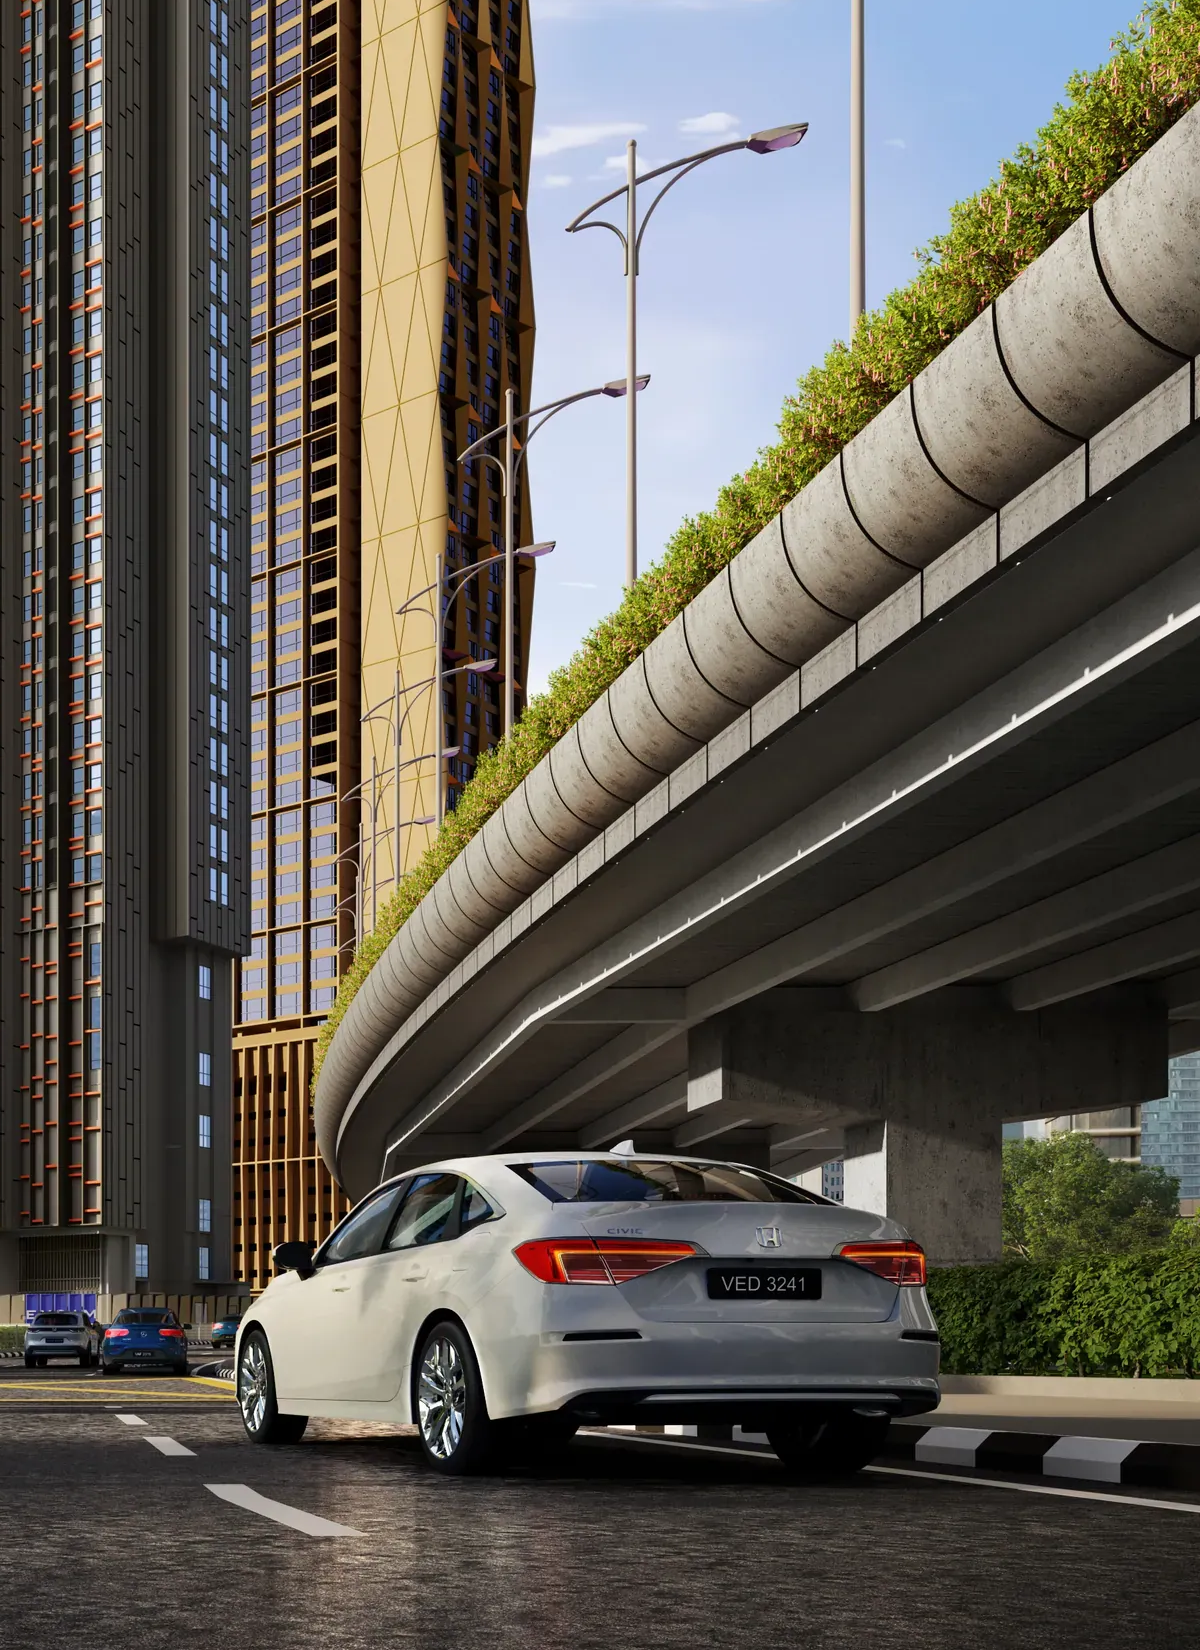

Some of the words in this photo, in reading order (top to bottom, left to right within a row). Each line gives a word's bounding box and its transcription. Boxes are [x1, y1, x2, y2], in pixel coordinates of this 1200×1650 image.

[606, 1227, 644, 1235] CIVIC
[721, 1276, 761, 1292] VED
[766, 1276, 806, 1292] 3241
